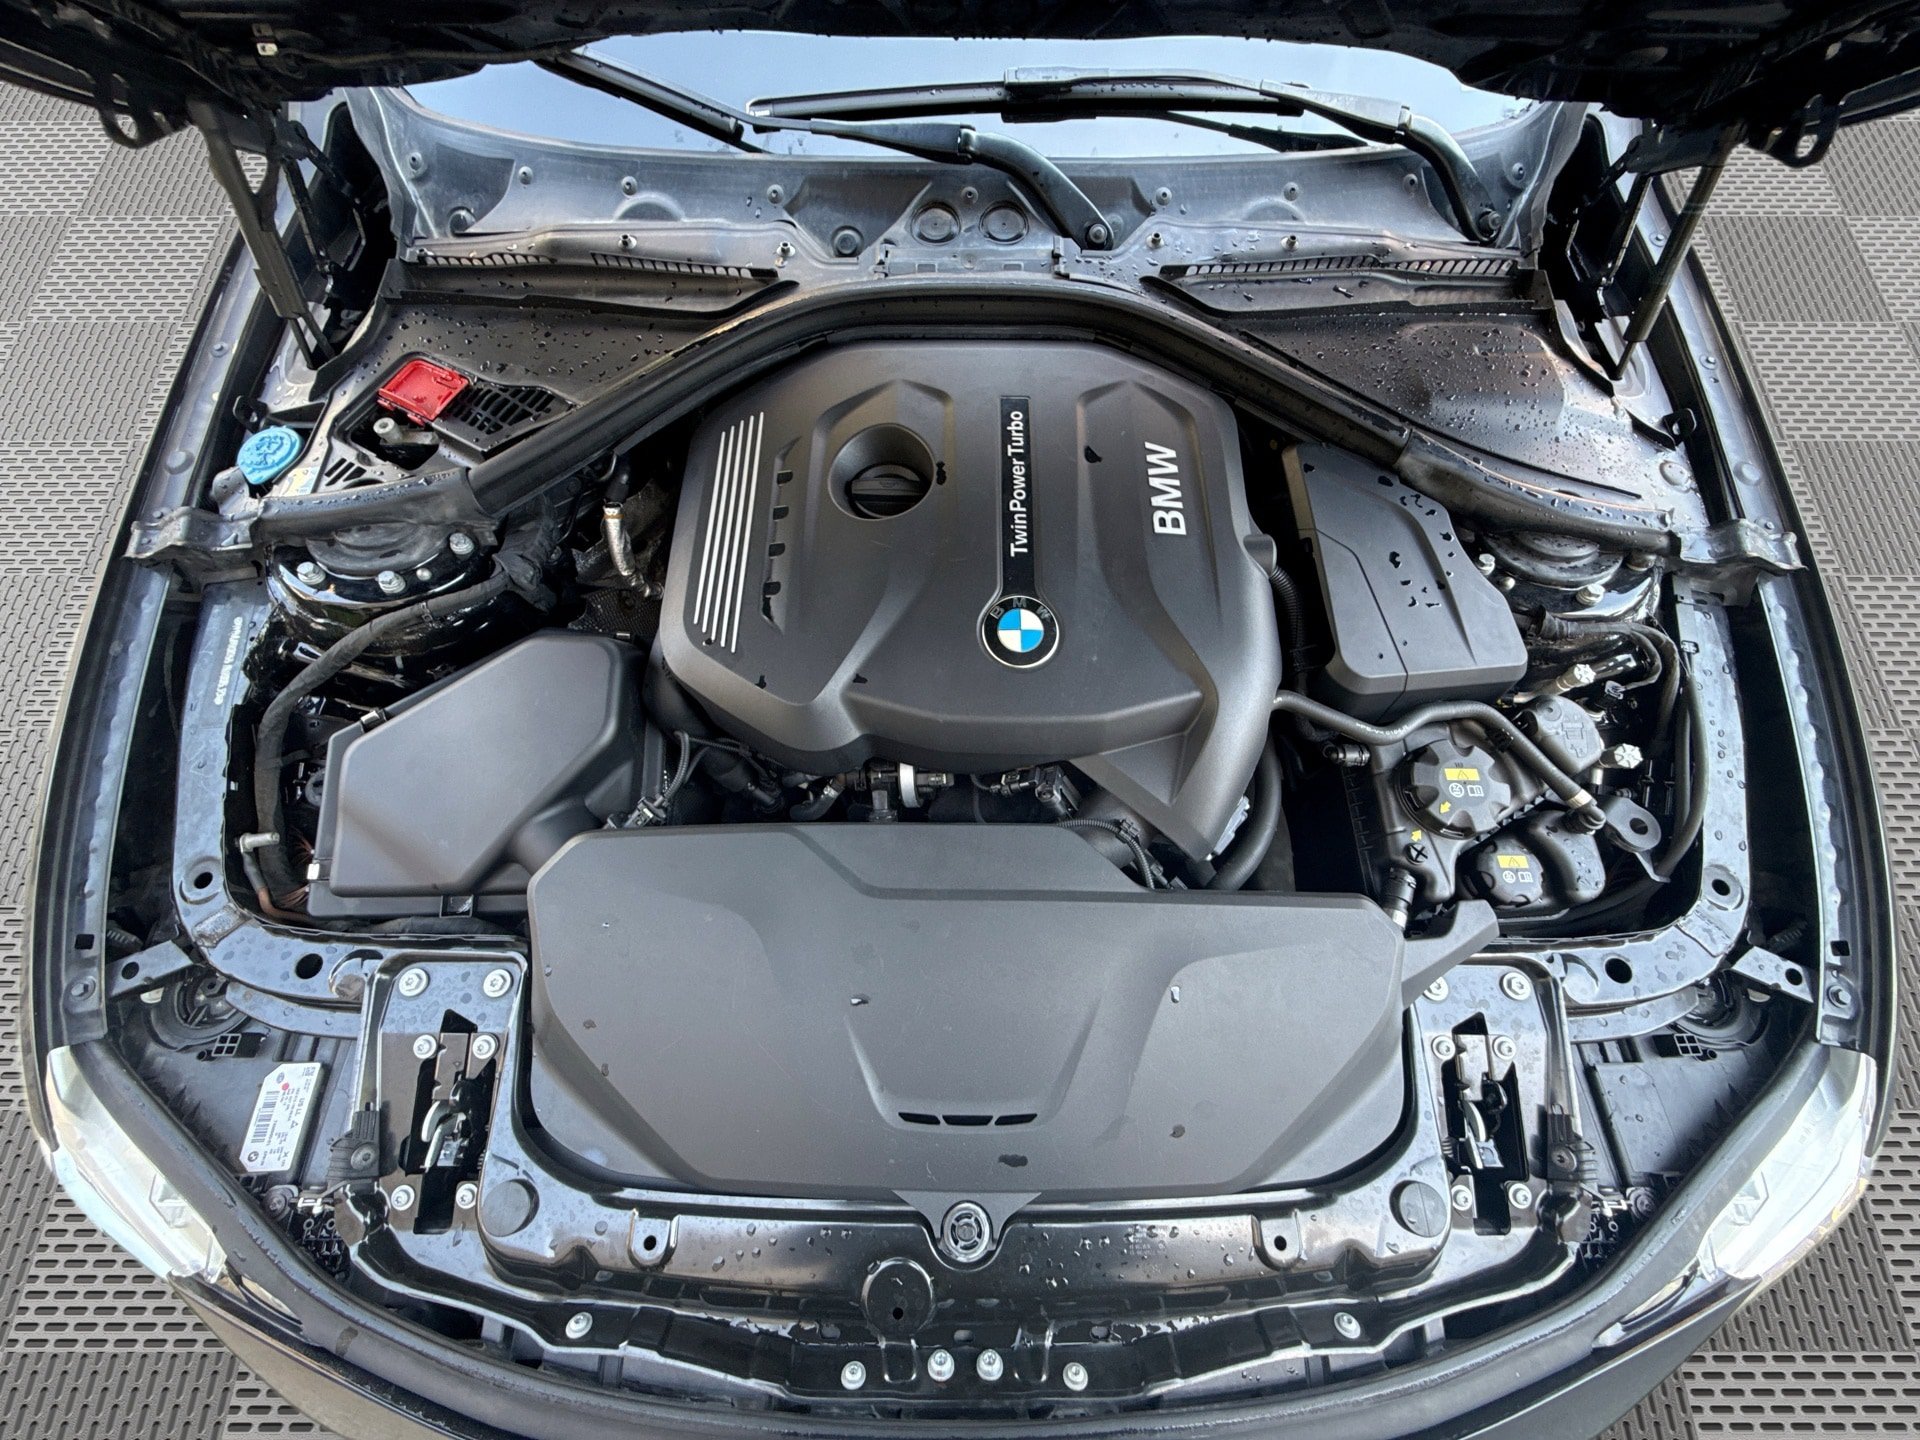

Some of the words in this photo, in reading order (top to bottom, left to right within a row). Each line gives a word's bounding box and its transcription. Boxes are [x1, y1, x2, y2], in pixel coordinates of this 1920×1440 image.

[1007, 410, 1025, 457] Turbo
[1144, 441, 1187, 536] BMW
[990, 597, 1051, 619] BMW
